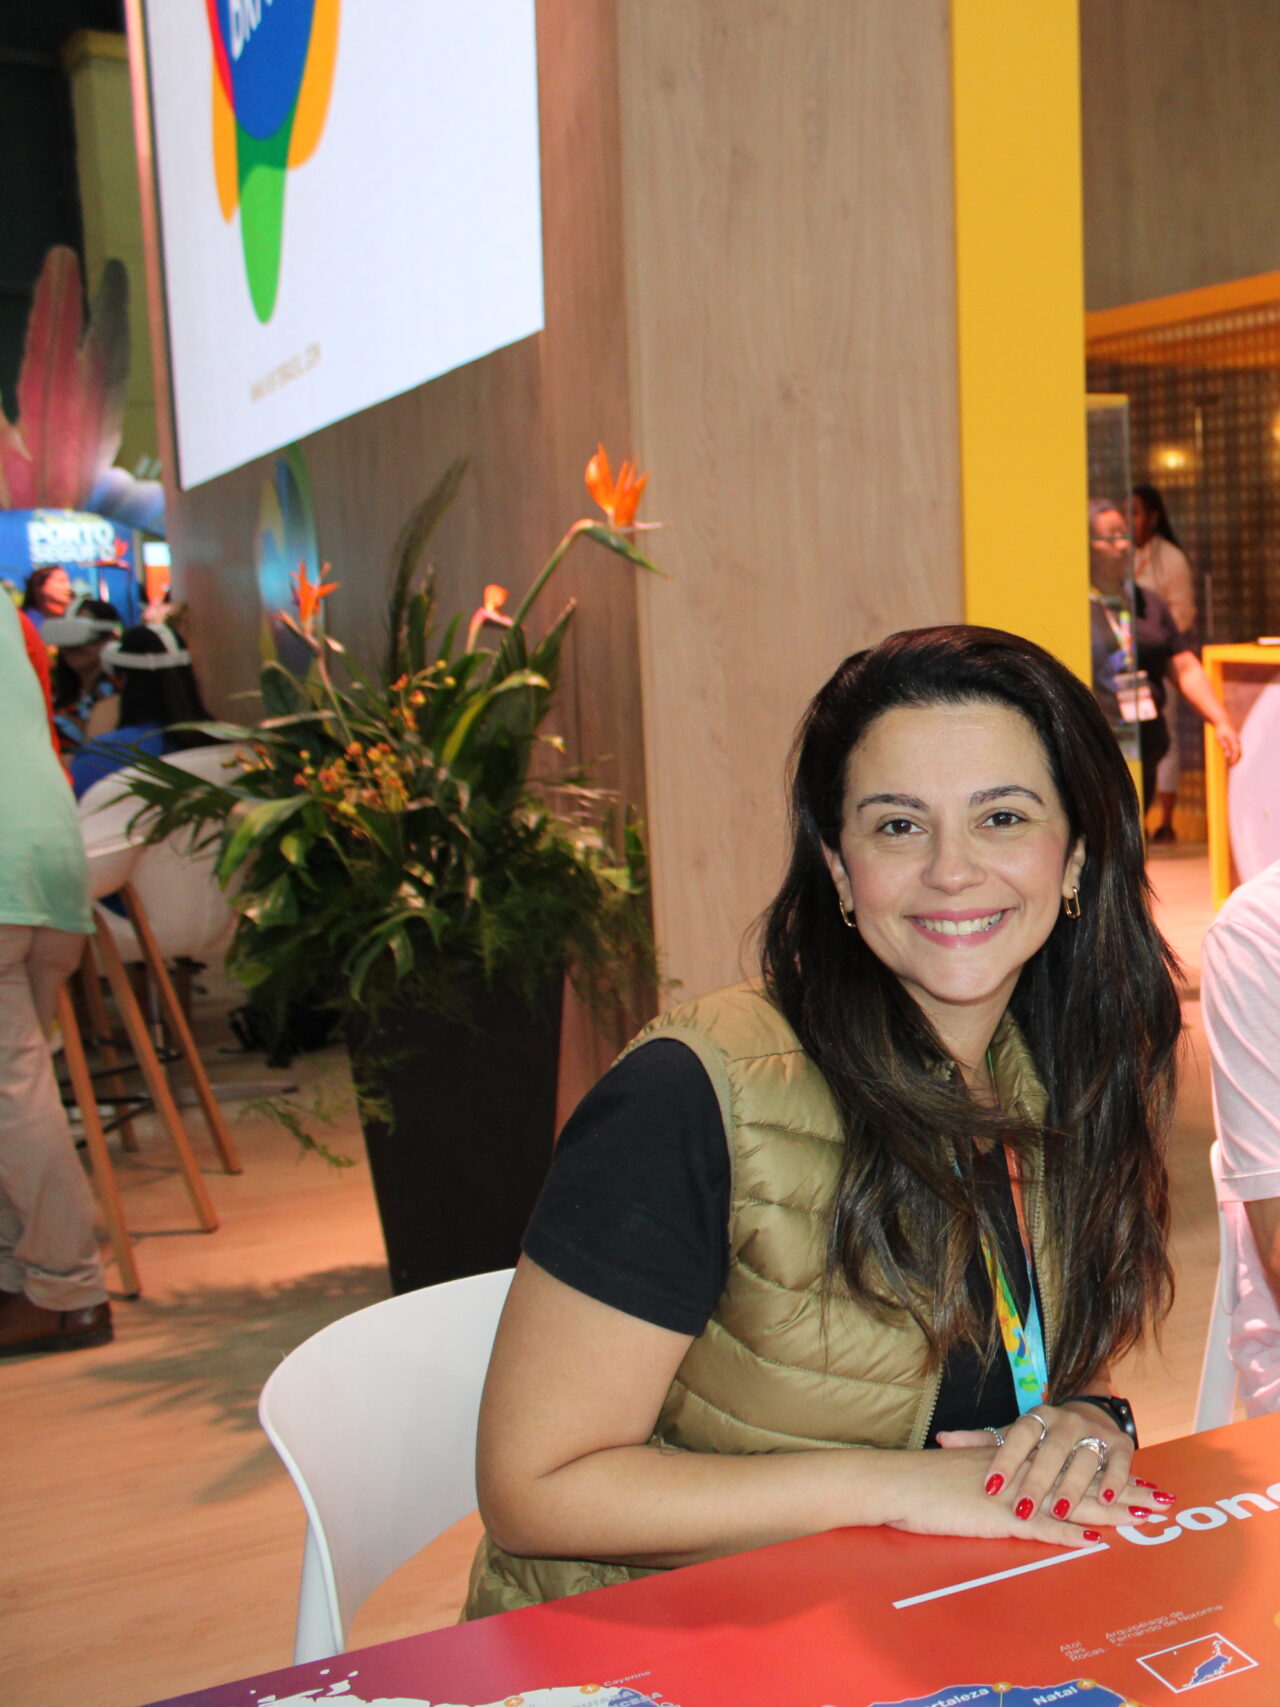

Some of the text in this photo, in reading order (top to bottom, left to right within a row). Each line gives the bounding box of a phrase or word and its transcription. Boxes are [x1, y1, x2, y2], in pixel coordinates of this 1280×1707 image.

[603, 1671, 652, 1687] Cayenne
[927, 1687, 990, 1707] rtaleza
[1032, 1686, 1078, 1706] Natal
